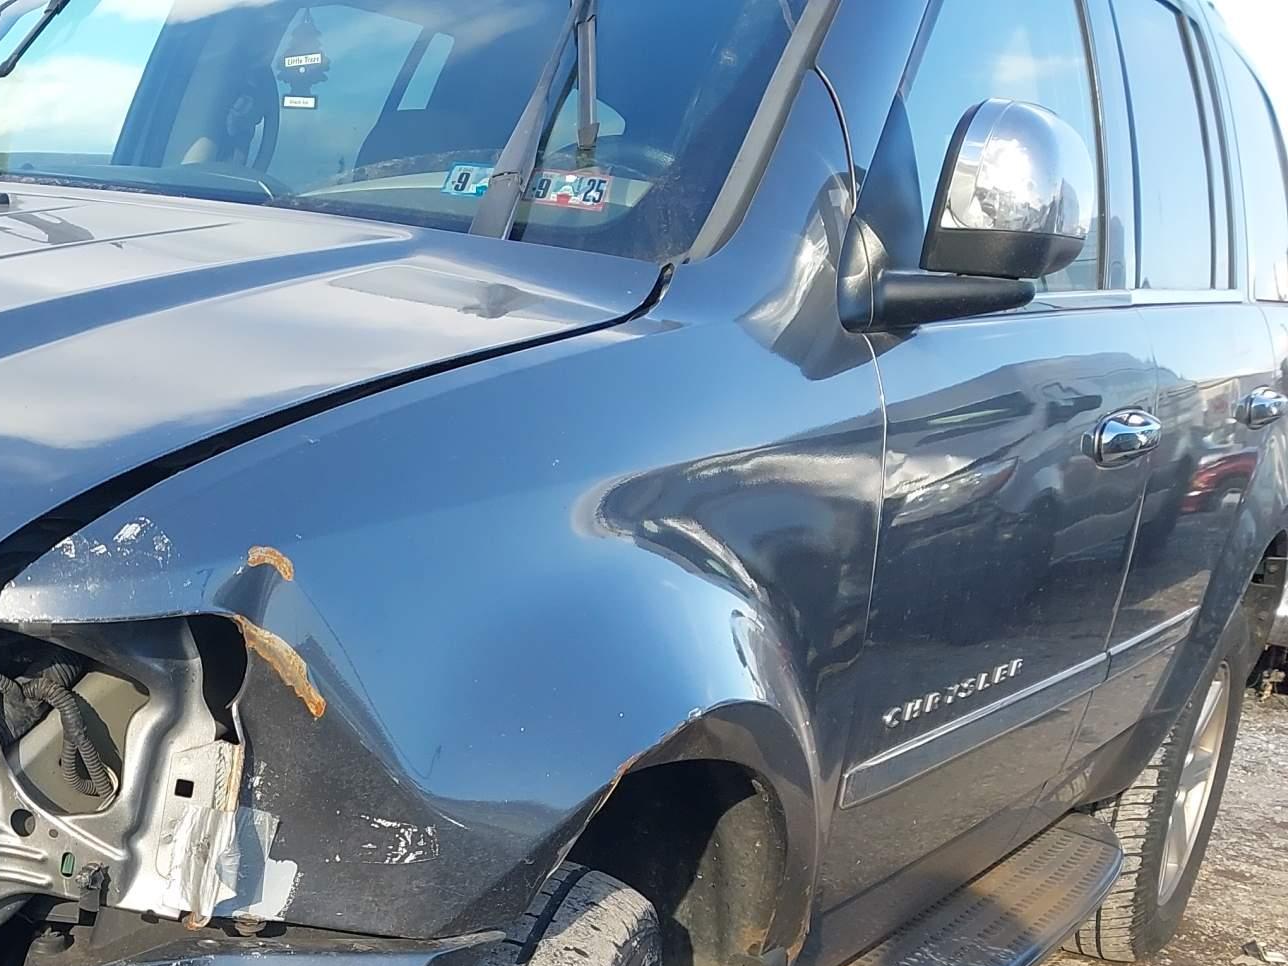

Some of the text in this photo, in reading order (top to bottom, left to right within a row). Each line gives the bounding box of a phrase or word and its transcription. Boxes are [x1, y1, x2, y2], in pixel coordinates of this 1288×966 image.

[454, 172, 471, 192] 9
[536, 178, 607, 204] 9 25
[881, 658, 1024, 728] CHRYSLER
